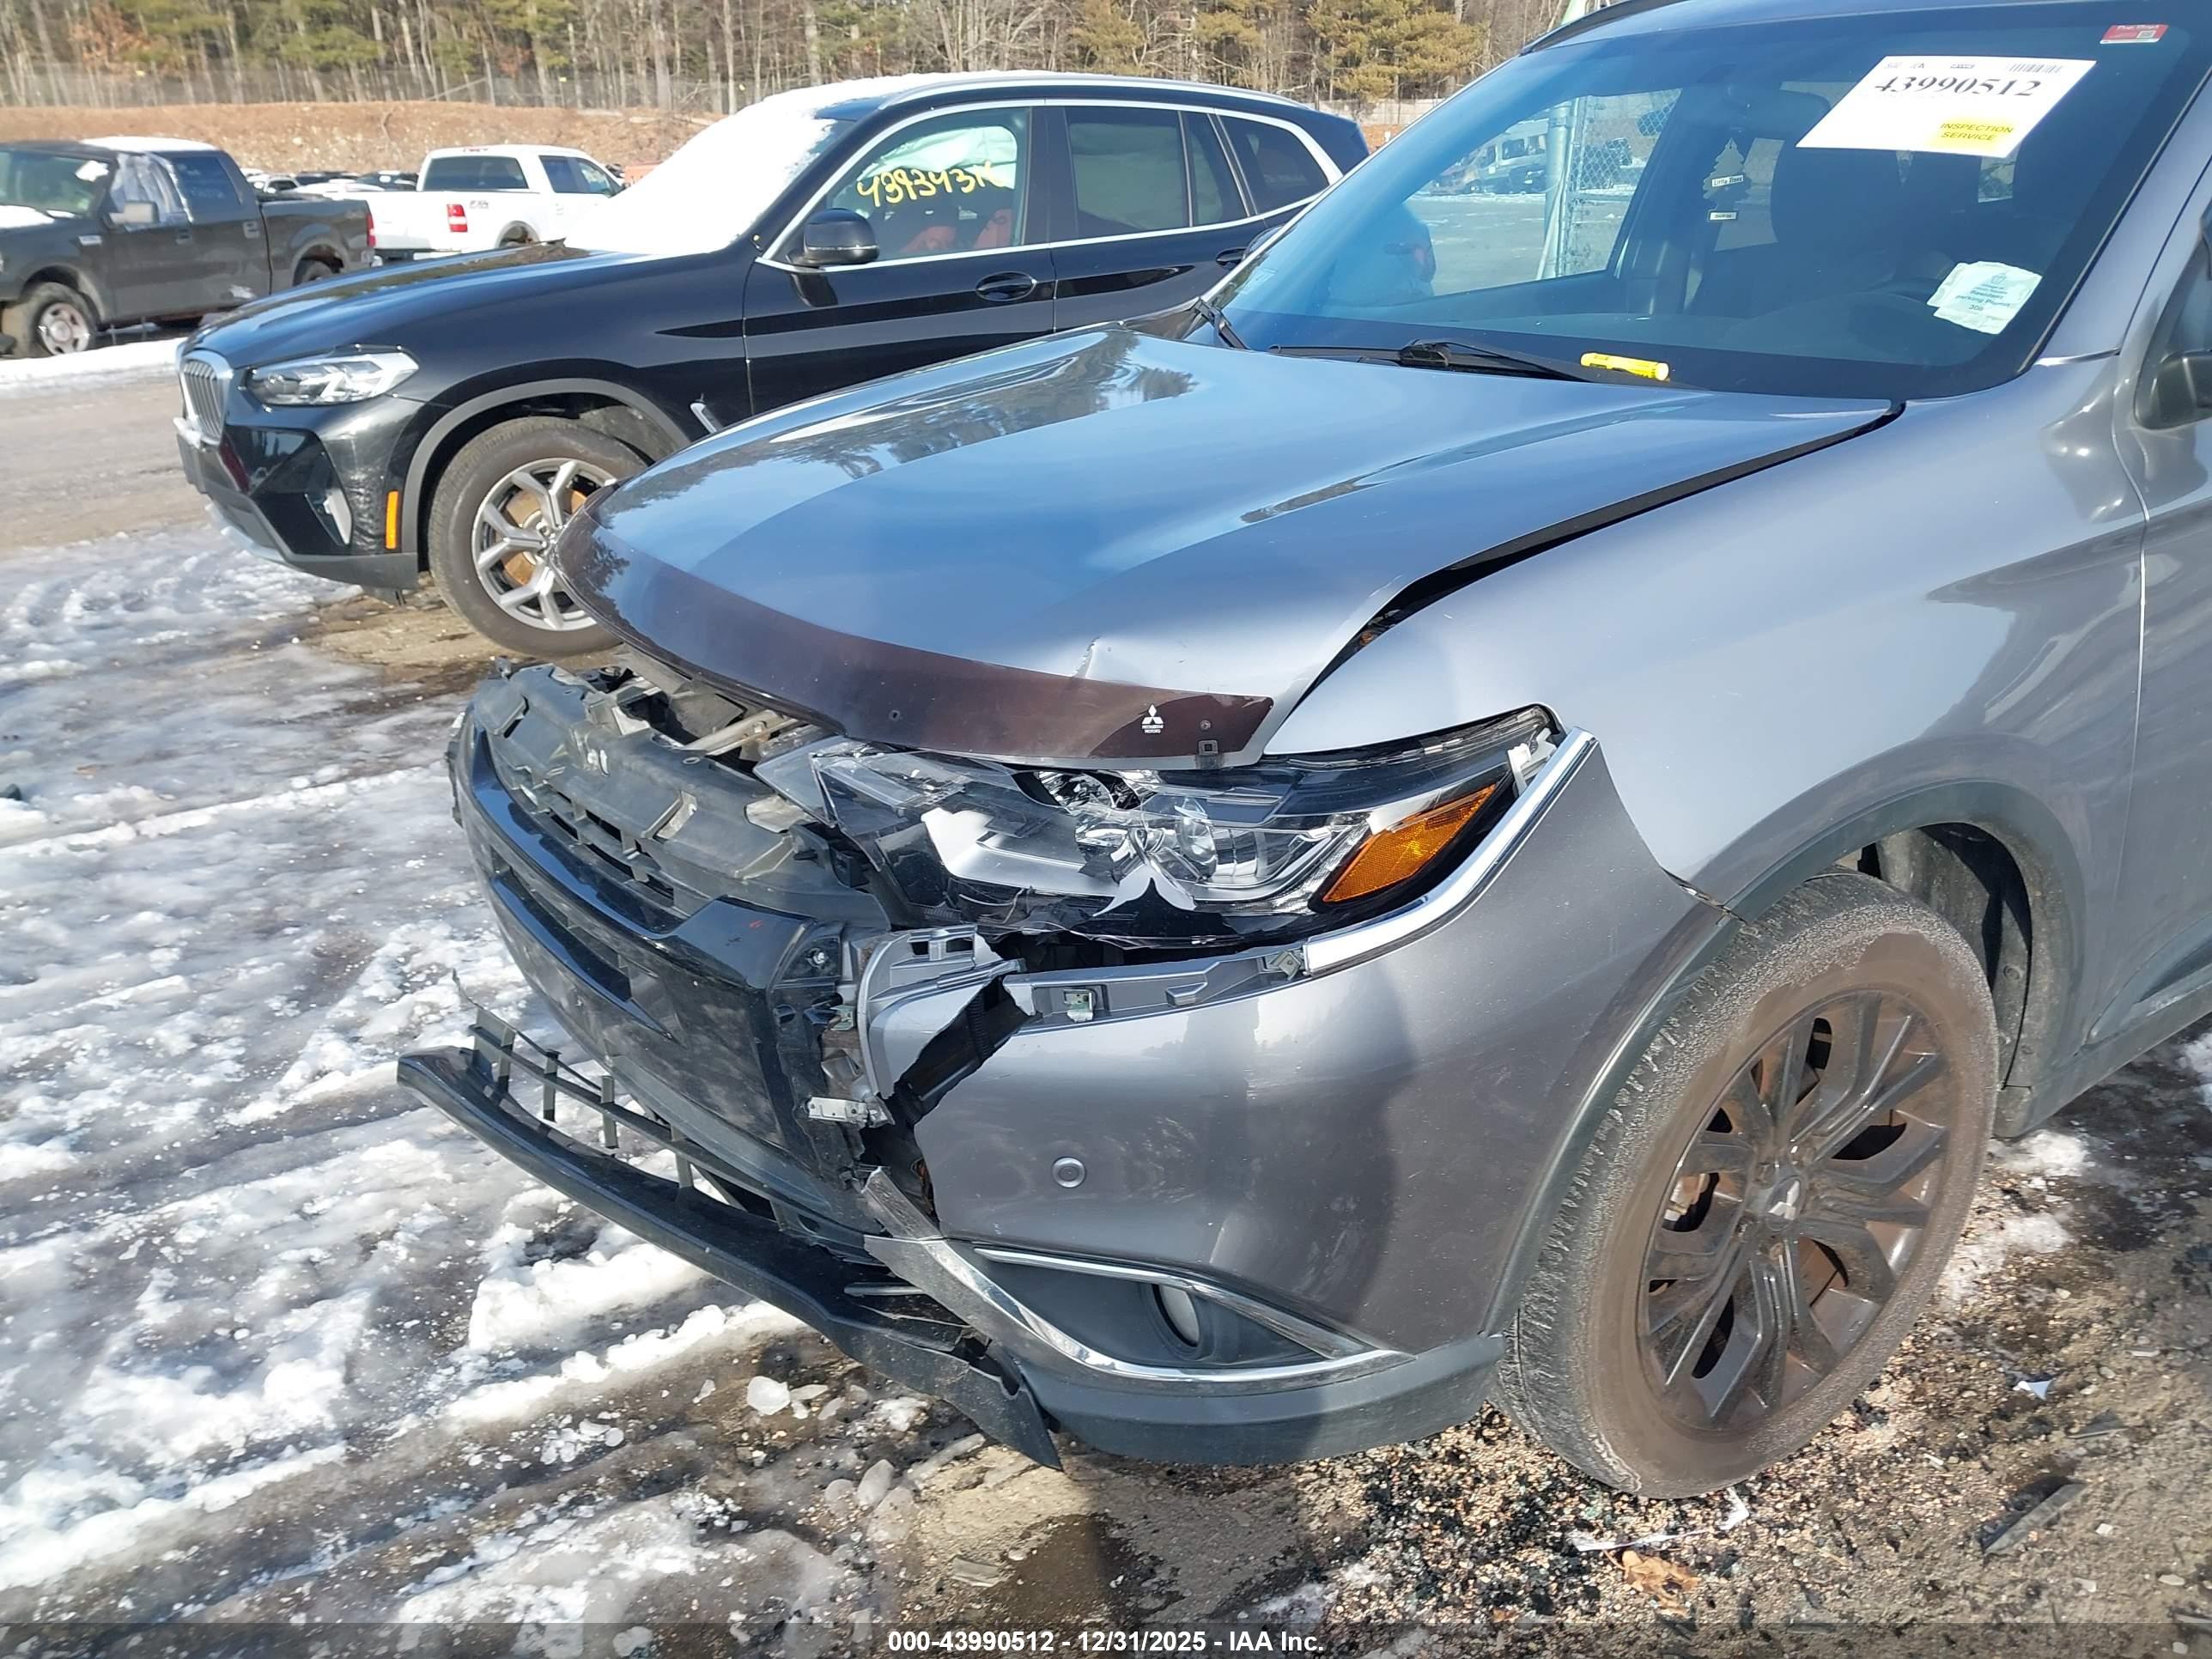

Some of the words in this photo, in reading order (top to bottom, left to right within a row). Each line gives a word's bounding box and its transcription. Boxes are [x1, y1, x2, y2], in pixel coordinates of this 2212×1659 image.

[1875, 76, 2042, 97] 43990512
[1940, 123, 2014, 133] INSPECTION
[1941, 131, 1997, 141] SERVICE
